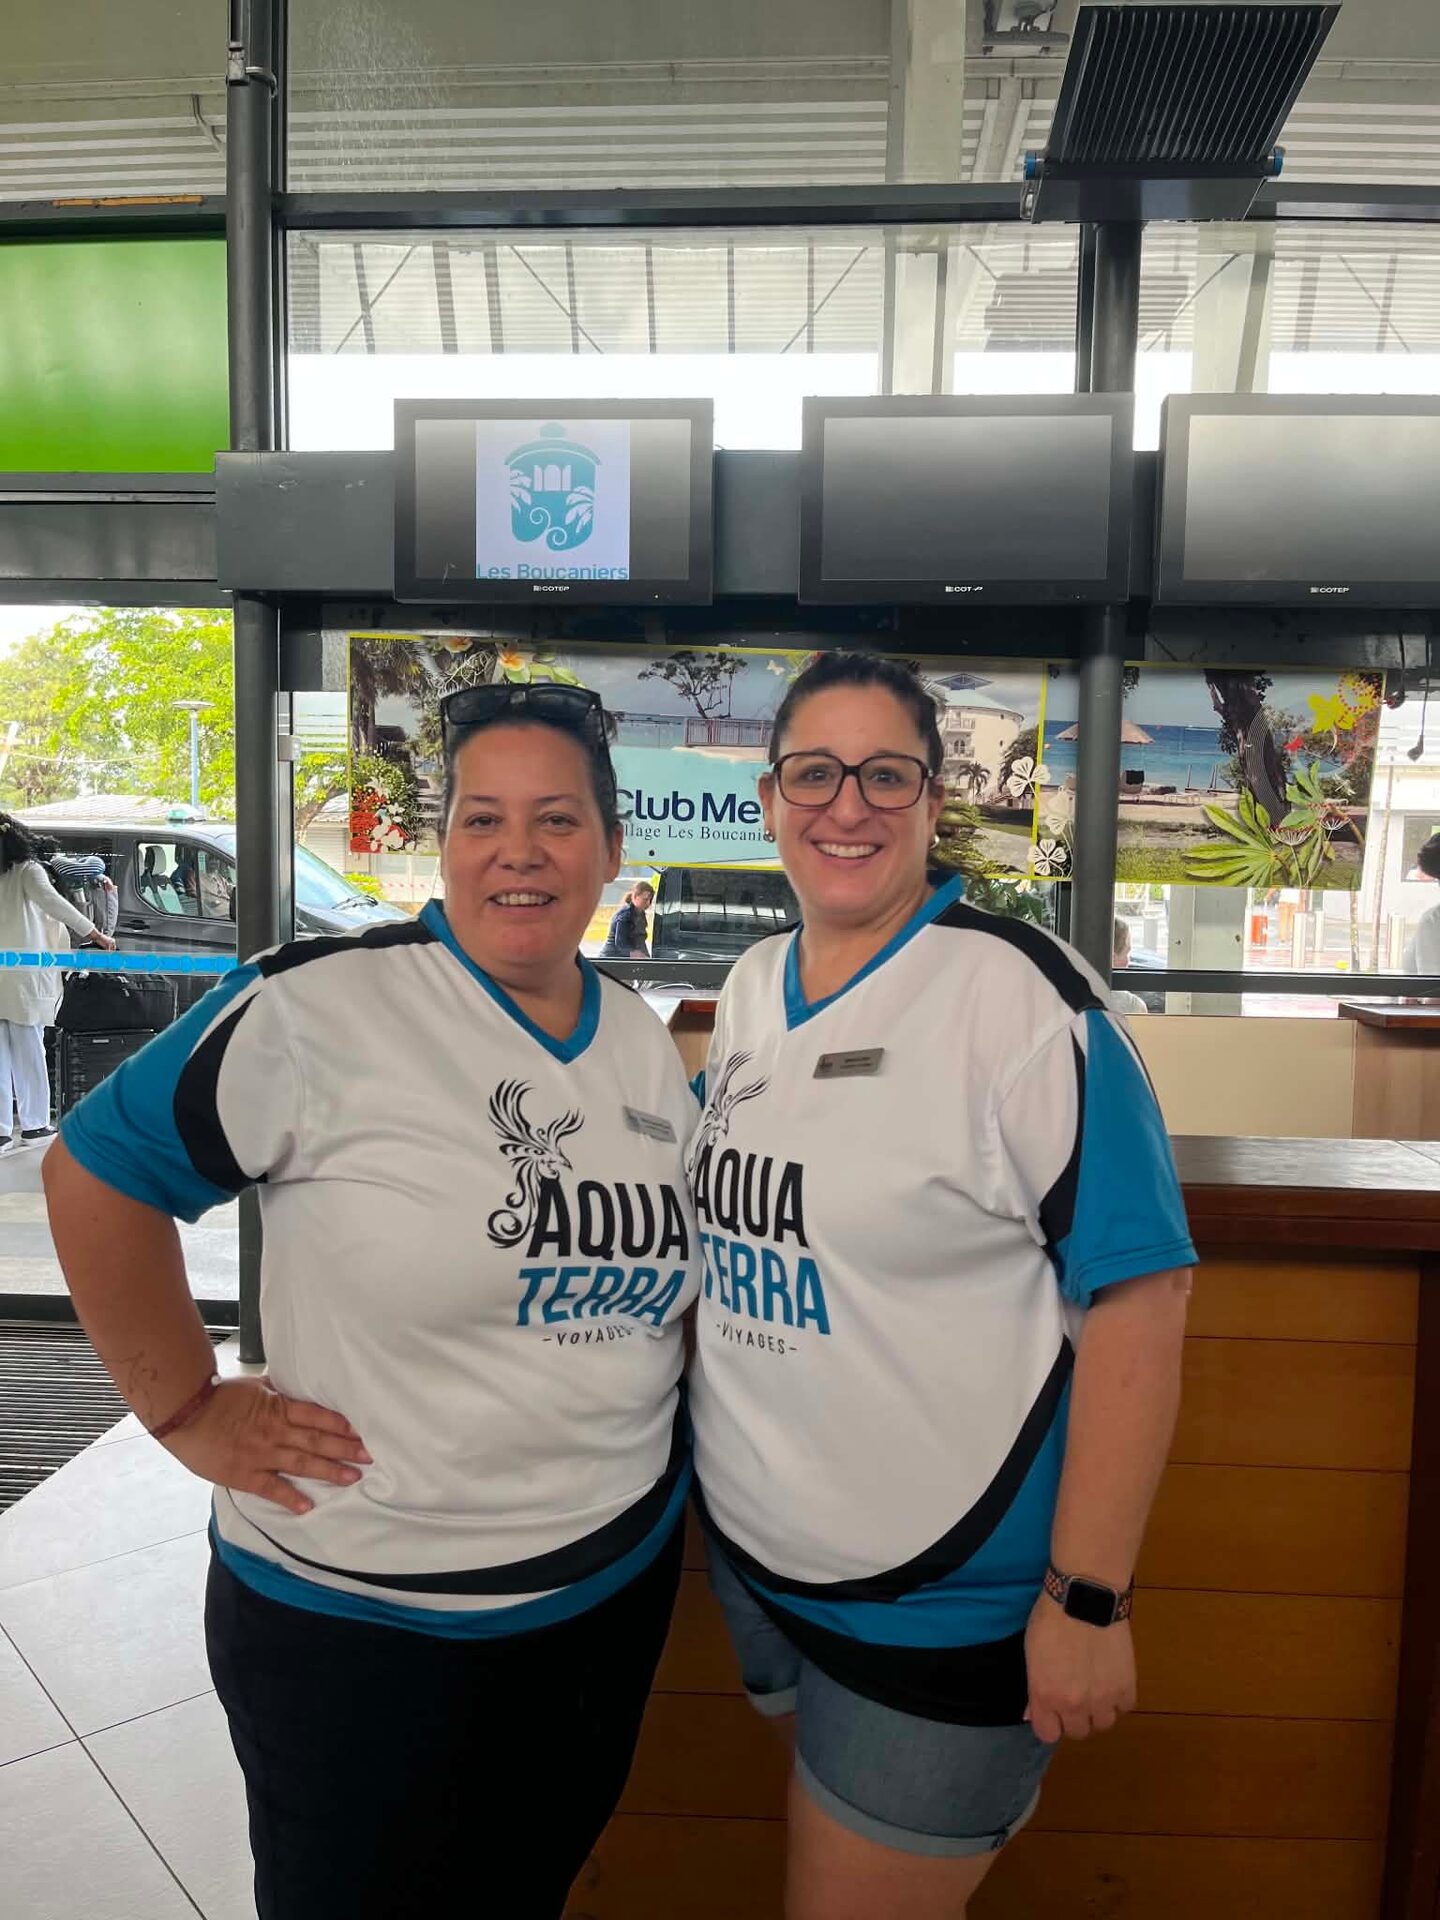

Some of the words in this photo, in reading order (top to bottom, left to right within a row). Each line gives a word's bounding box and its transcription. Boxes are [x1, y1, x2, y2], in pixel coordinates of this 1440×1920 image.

[477, 564, 511, 579] Les
[517, 564, 628, 579] Boucaniers
[616, 789, 695, 821] Club
[701, 792, 765, 824] Me
[625, 823, 661, 840] llage
[668, 825, 694, 839] Les
[701, 826, 762, 841] Boucani
[526, 1176, 690, 1261] AQUA
[694, 1144, 811, 1249] AQUA
[516, 1266, 687, 1327] TERRA
[698, 1231, 831, 1336] TERRA
